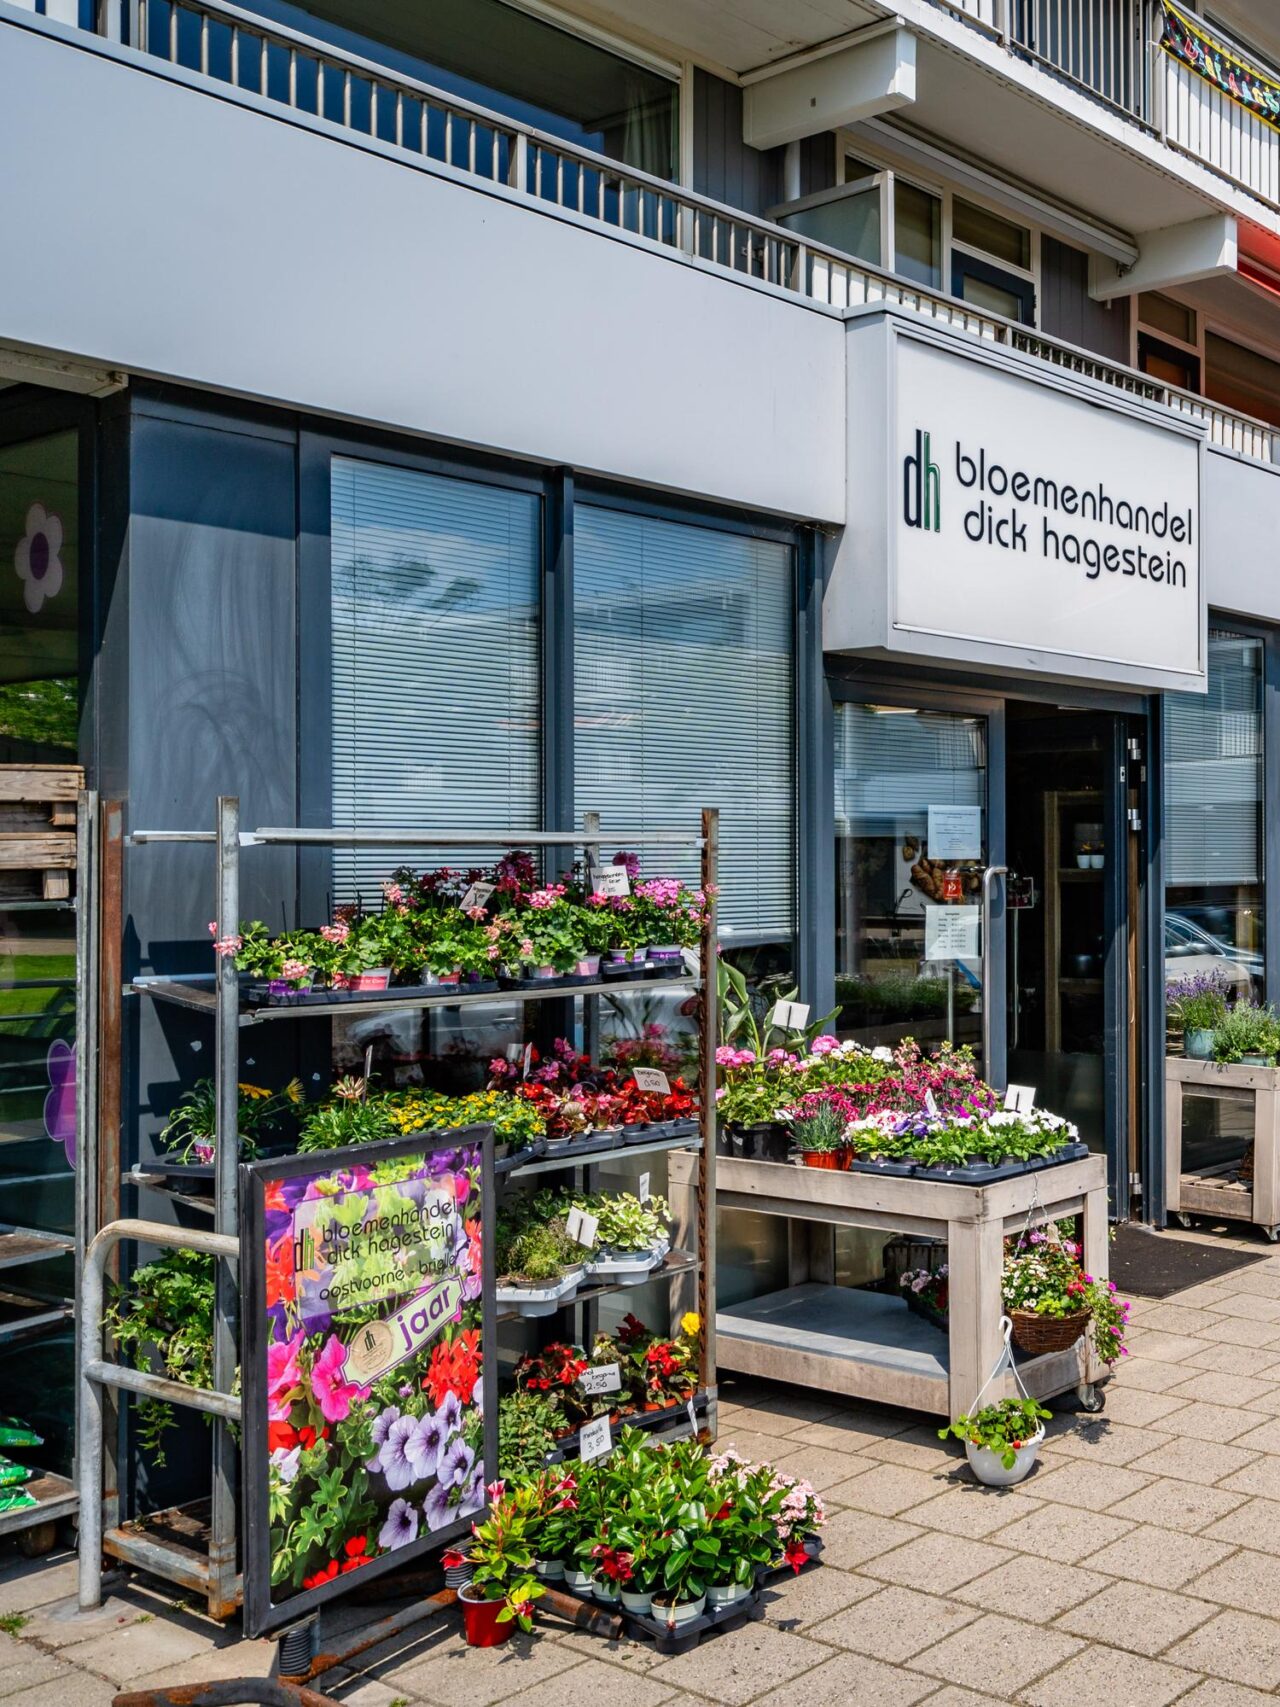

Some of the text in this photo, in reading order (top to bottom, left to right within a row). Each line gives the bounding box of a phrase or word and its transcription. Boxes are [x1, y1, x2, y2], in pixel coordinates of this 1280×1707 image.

[904, 429, 941, 533] dh
[955, 440, 1193, 546] bloemenhandel
[963, 499, 1187, 588] dick hagestein
[322, 1195, 458, 1244] bloemenhandel
[326, 1222, 454, 1266] dick hagestein
[294, 1228, 315, 1272] dh
[319, 1267, 405, 1301] oostvoorne
[418, 1253, 458, 1276] brielle
[397, 1284, 453, 1352] jaar
